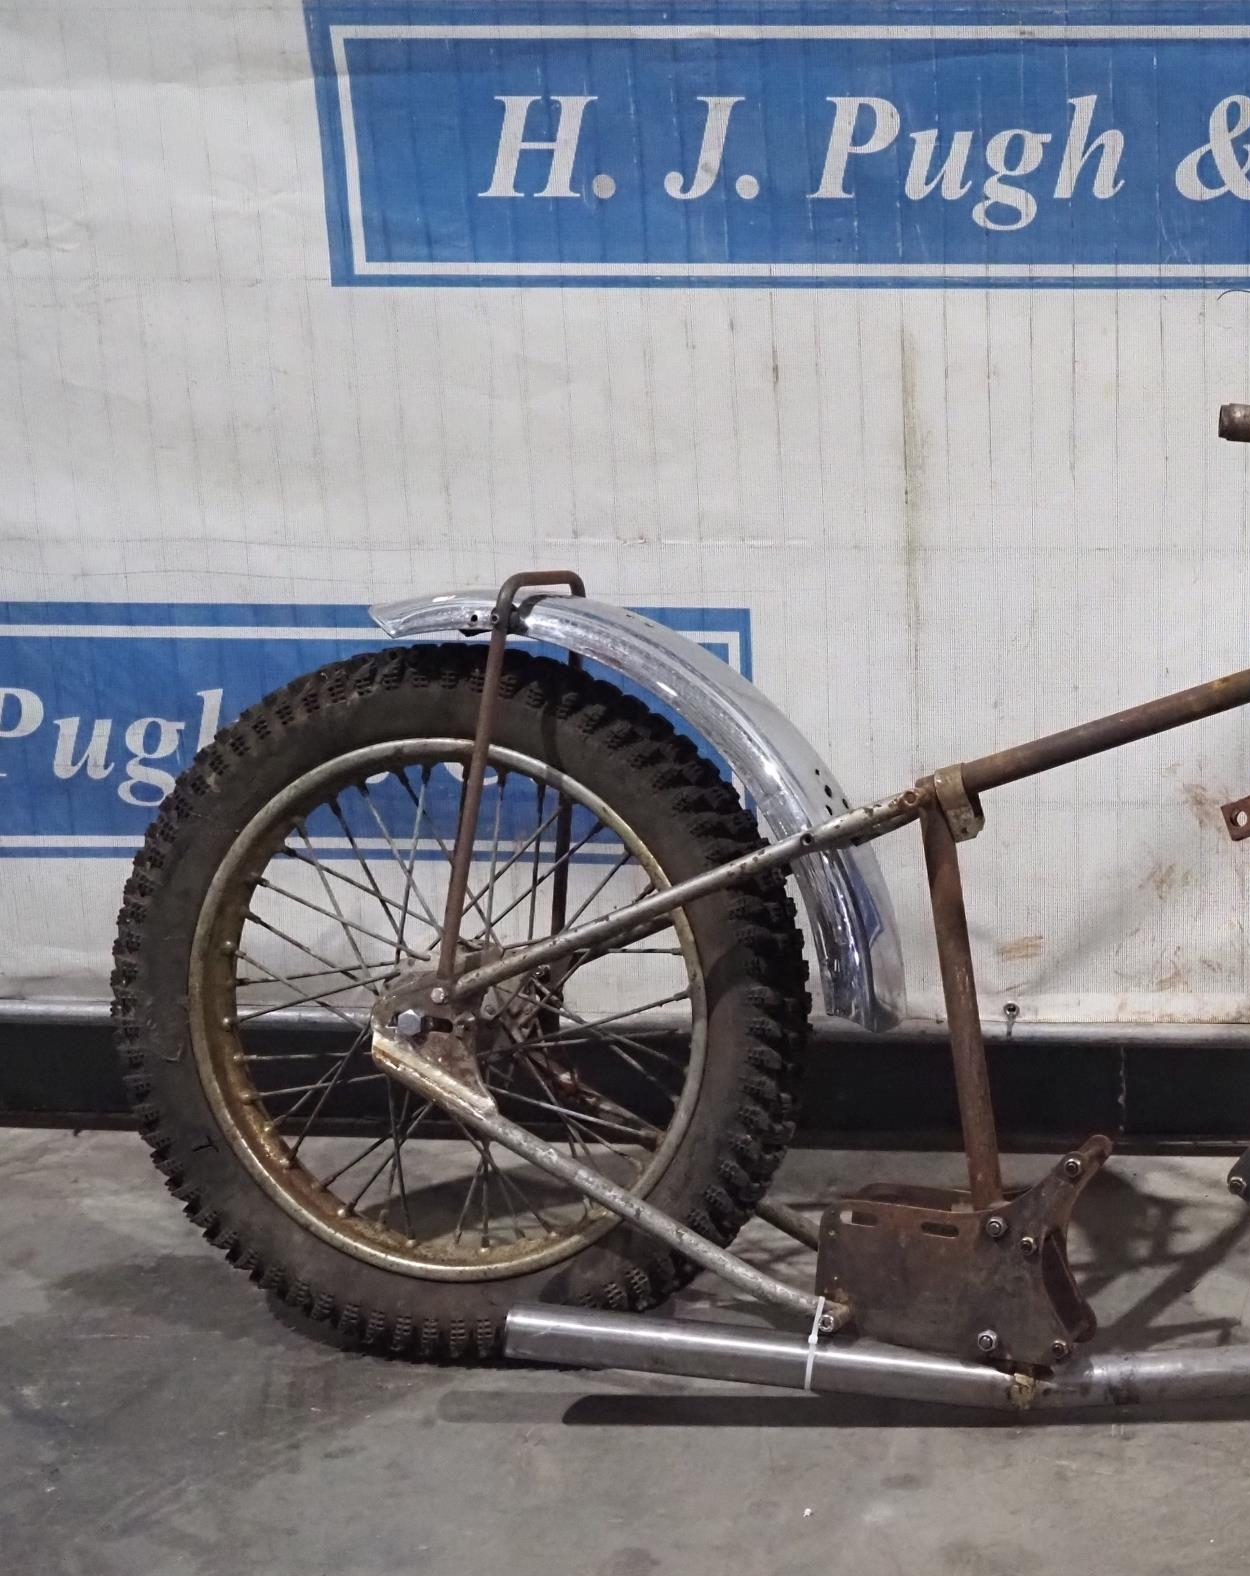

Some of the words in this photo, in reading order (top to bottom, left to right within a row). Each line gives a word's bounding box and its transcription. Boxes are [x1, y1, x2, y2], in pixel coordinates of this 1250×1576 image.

[477, 94, 617, 199] H.
[663, 96, 760, 200] J.
[805, 93, 1126, 233] Pugh
